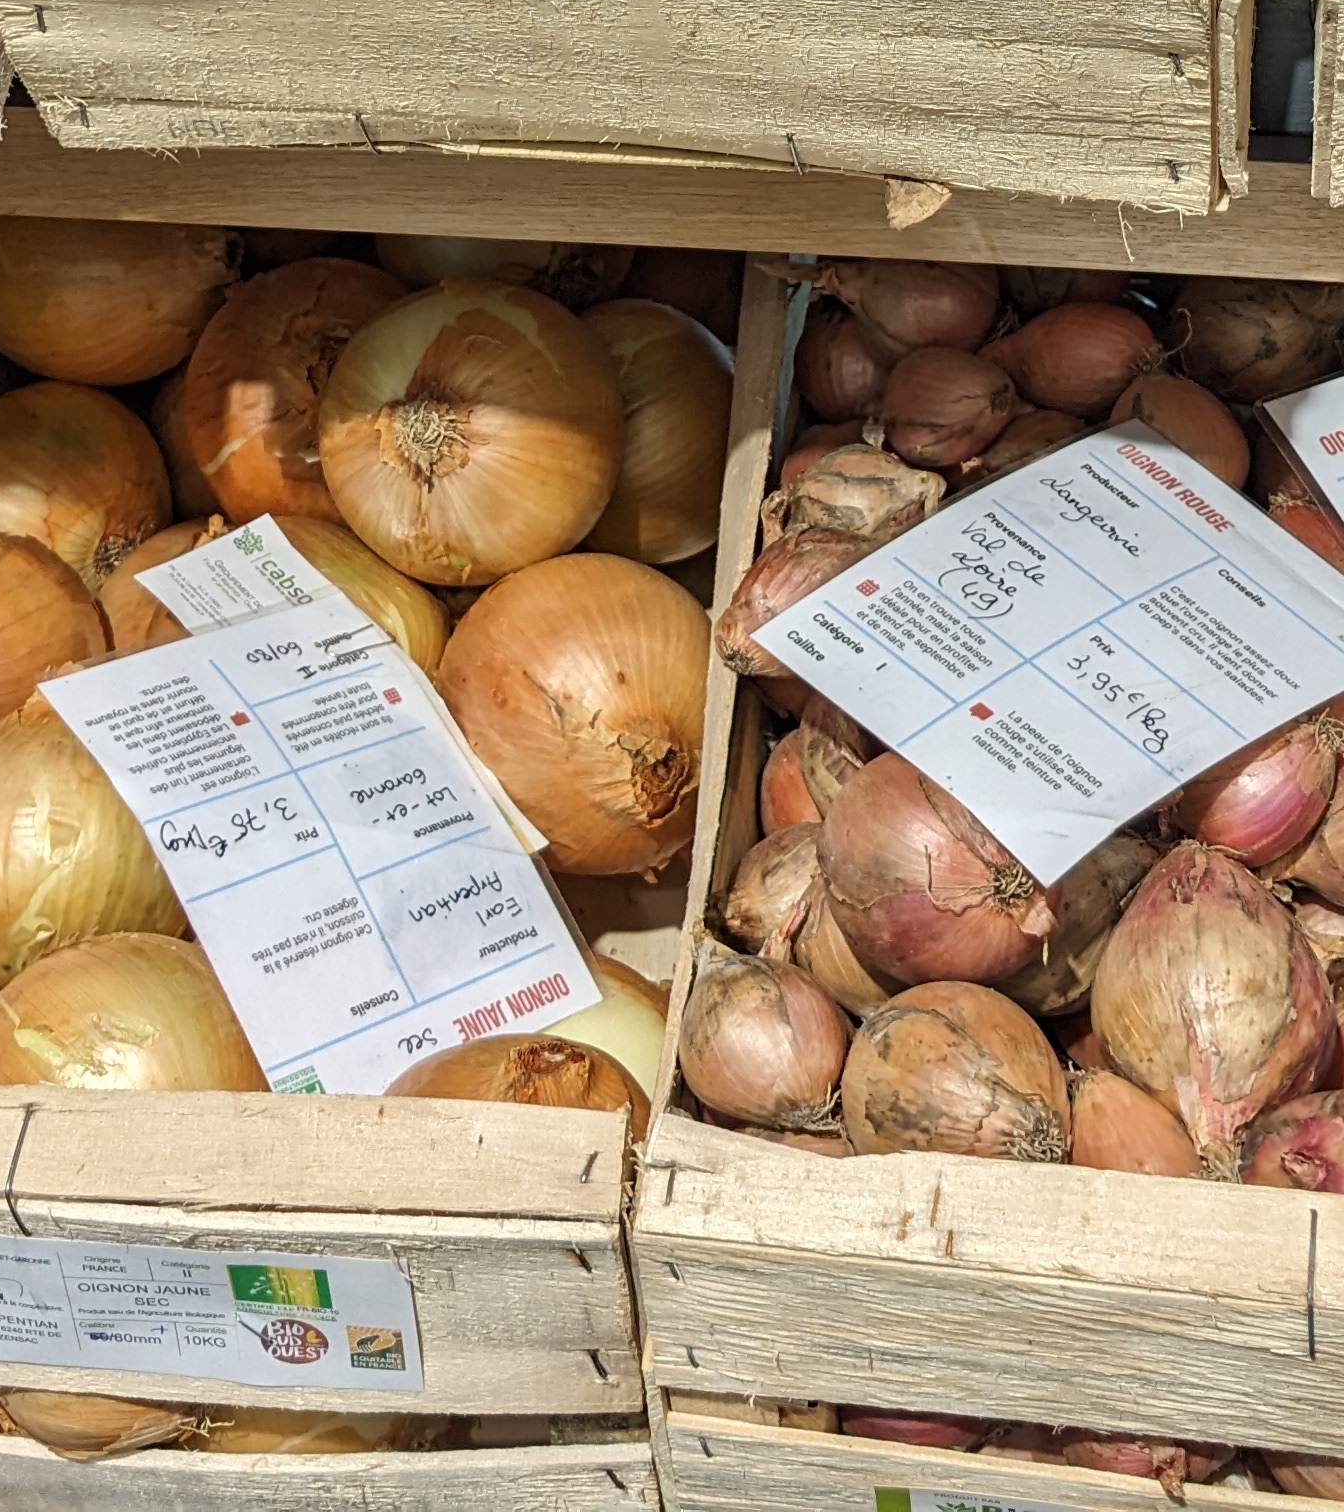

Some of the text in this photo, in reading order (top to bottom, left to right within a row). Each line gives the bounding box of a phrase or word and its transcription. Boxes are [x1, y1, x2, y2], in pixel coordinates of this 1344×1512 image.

[1079, 463, 1140, 509] Producteur
[1116, 443, 1236, 533] OIGNON ROUGE
[983, 511, 1047, 562] Provenance
[960, 520, 1046, 587] Val de
[261, 558, 313, 605] cabso
[1217, 568, 1267, 608] Conseils
[786, 630, 826, 662] Calibre
[812, 612, 865, 655] Catégorie
[1088, 634, 1116, 657] Prix
[318, 647, 369, 672] Catégorie
[971, 734, 1017, 774] naturelle.
[984, 727, 1062, 791] comme teinture
[995, 719, 1096, 798] rouge s'utilise aussi
[1007, 710, 1103, 789] La peau de l'oignon
[293, 826, 320, 842] Prix
[413, 810, 475, 839] Provenance
[302, 896, 359, 924] digeste cru.
[251, 909, 366, 962] cuisson, il n'est pas très
[262, 923, 373, 974] Cet oignon réservé à la
[478, 925, 539, 959] Producteur
[349, 989, 400, 1017] Conseils
[452, 973, 570, 1046] OIGNON JAUNE
[82, 1264, 127, 1273] FRANCE
[84, 1255, 121, 1265] Origine
[161, 1260, 211, 1271] Catégorie
[77, 1282, 212, 1297] OIGNON JAUNE
[134, 1297, 170, 1307] SEC
[47, 1330, 62, 1338] DE
[184, 1335, 227, 1348] 10KG
[186, 1326, 227, 1335] Quantité
[268, 1346, 328, 1359] OUEST
